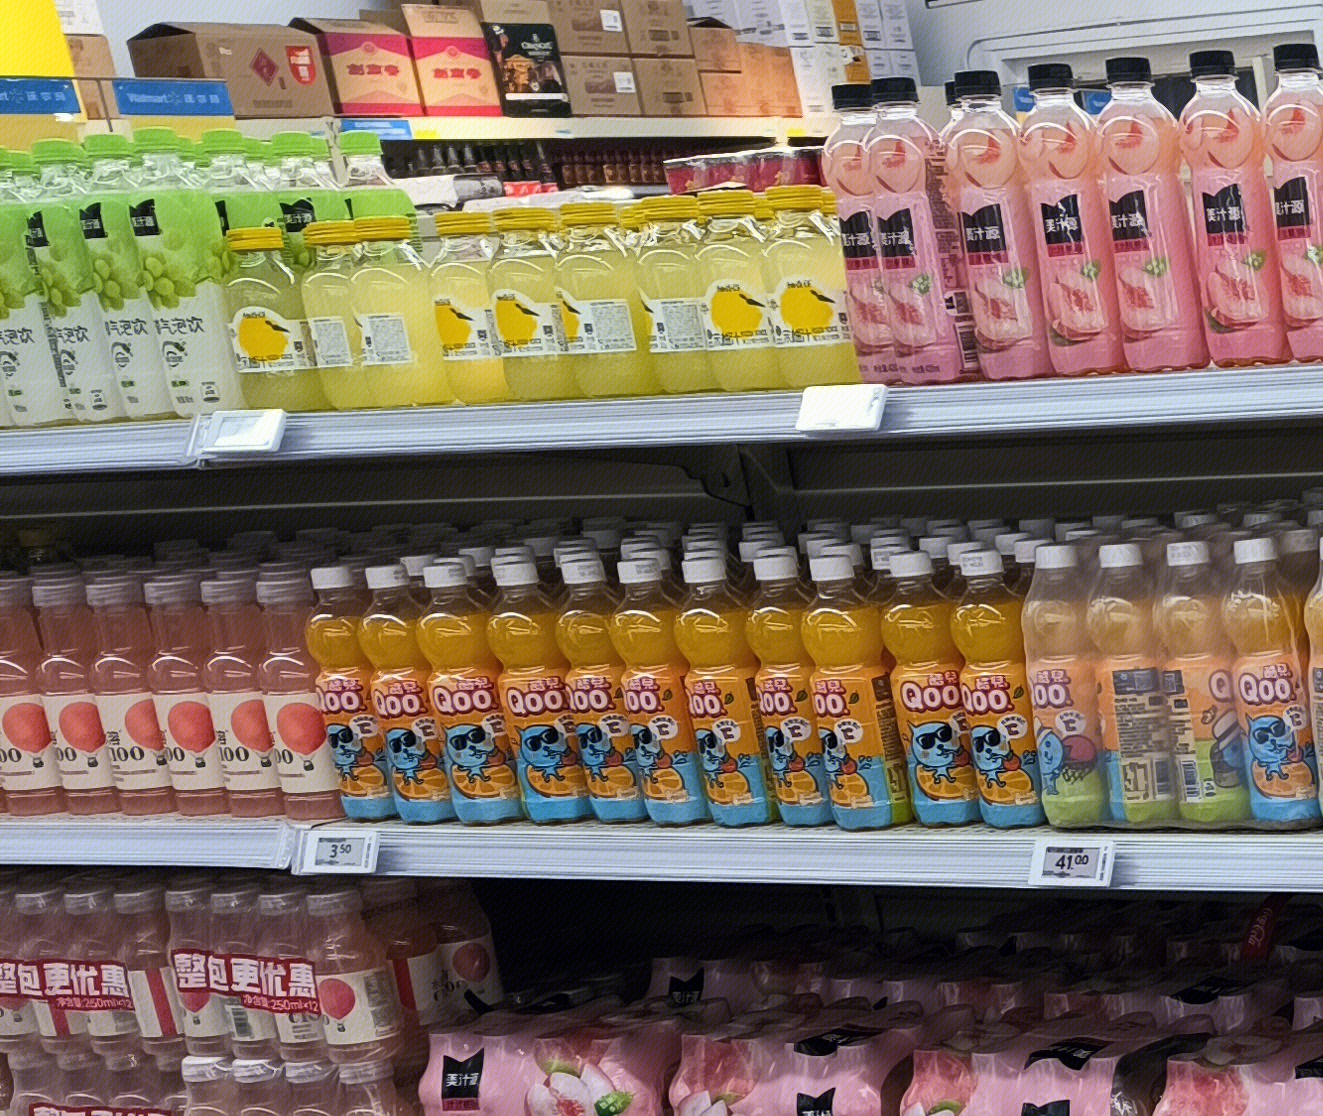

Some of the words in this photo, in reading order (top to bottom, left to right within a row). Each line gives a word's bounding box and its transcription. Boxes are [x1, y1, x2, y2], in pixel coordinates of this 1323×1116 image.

[434, 685, 496, 715] Qoo
[506, 686, 567, 714] Qoo
[1239, 674, 1297, 704] Qoo
[1054, 853, 1090, 873] 41.00
[175, 951, 318, 1000] 整包更优惠
